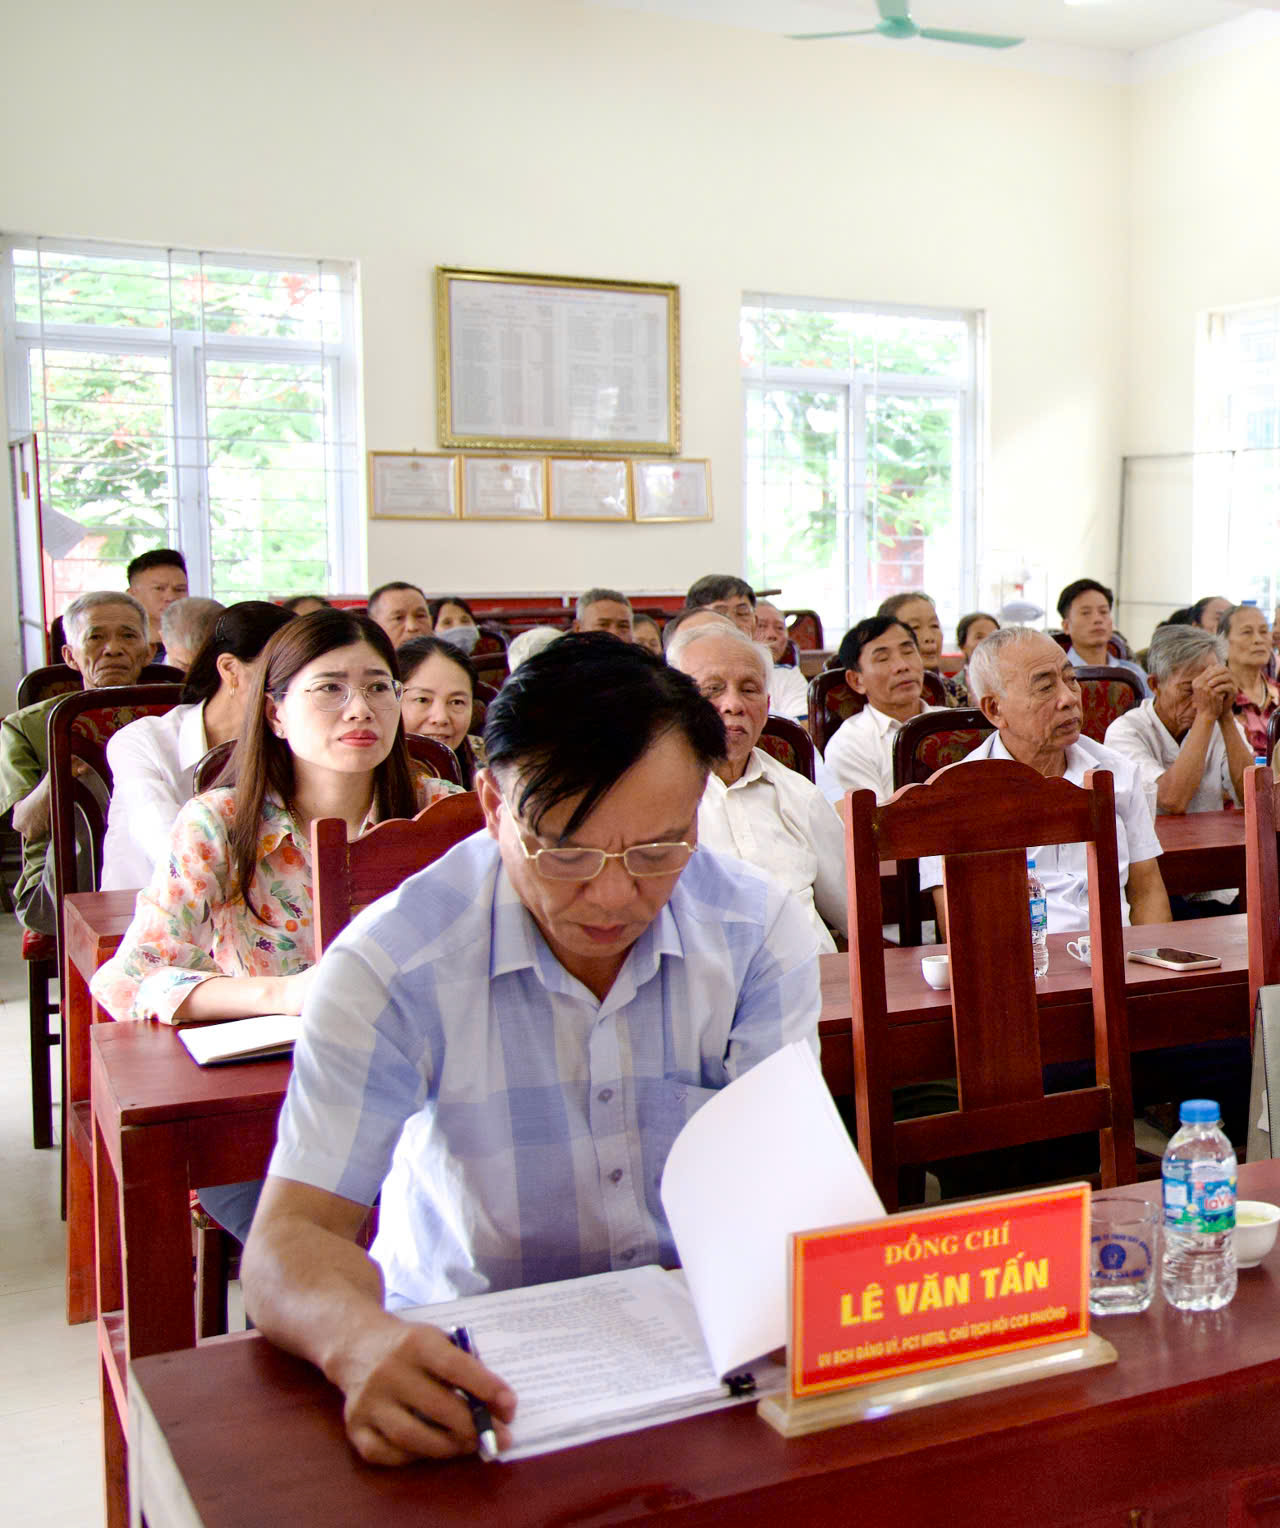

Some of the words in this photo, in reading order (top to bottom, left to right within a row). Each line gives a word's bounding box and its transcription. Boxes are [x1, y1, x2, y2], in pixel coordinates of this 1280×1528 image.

[965, 1220, 1011, 1251] CHÍ
[840, 1283, 884, 1326] LÊ
[896, 1272, 970, 1315] VĂN
[980, 1251, 1049, 1299] TẤN
[833, 1348, 855, 1364] BCH
[856, 1339, 884, 1361] ĐẢNG
[902, 1335, 920, 1350] PCT
[950, 1320, 969, 1341] CHỦ
[970, 1321, 991, 1338] TỊCH
[1010, 1312, 1029, 1329] CCB
[1030, 1305, 1067, 1324] PHƯỜNG
